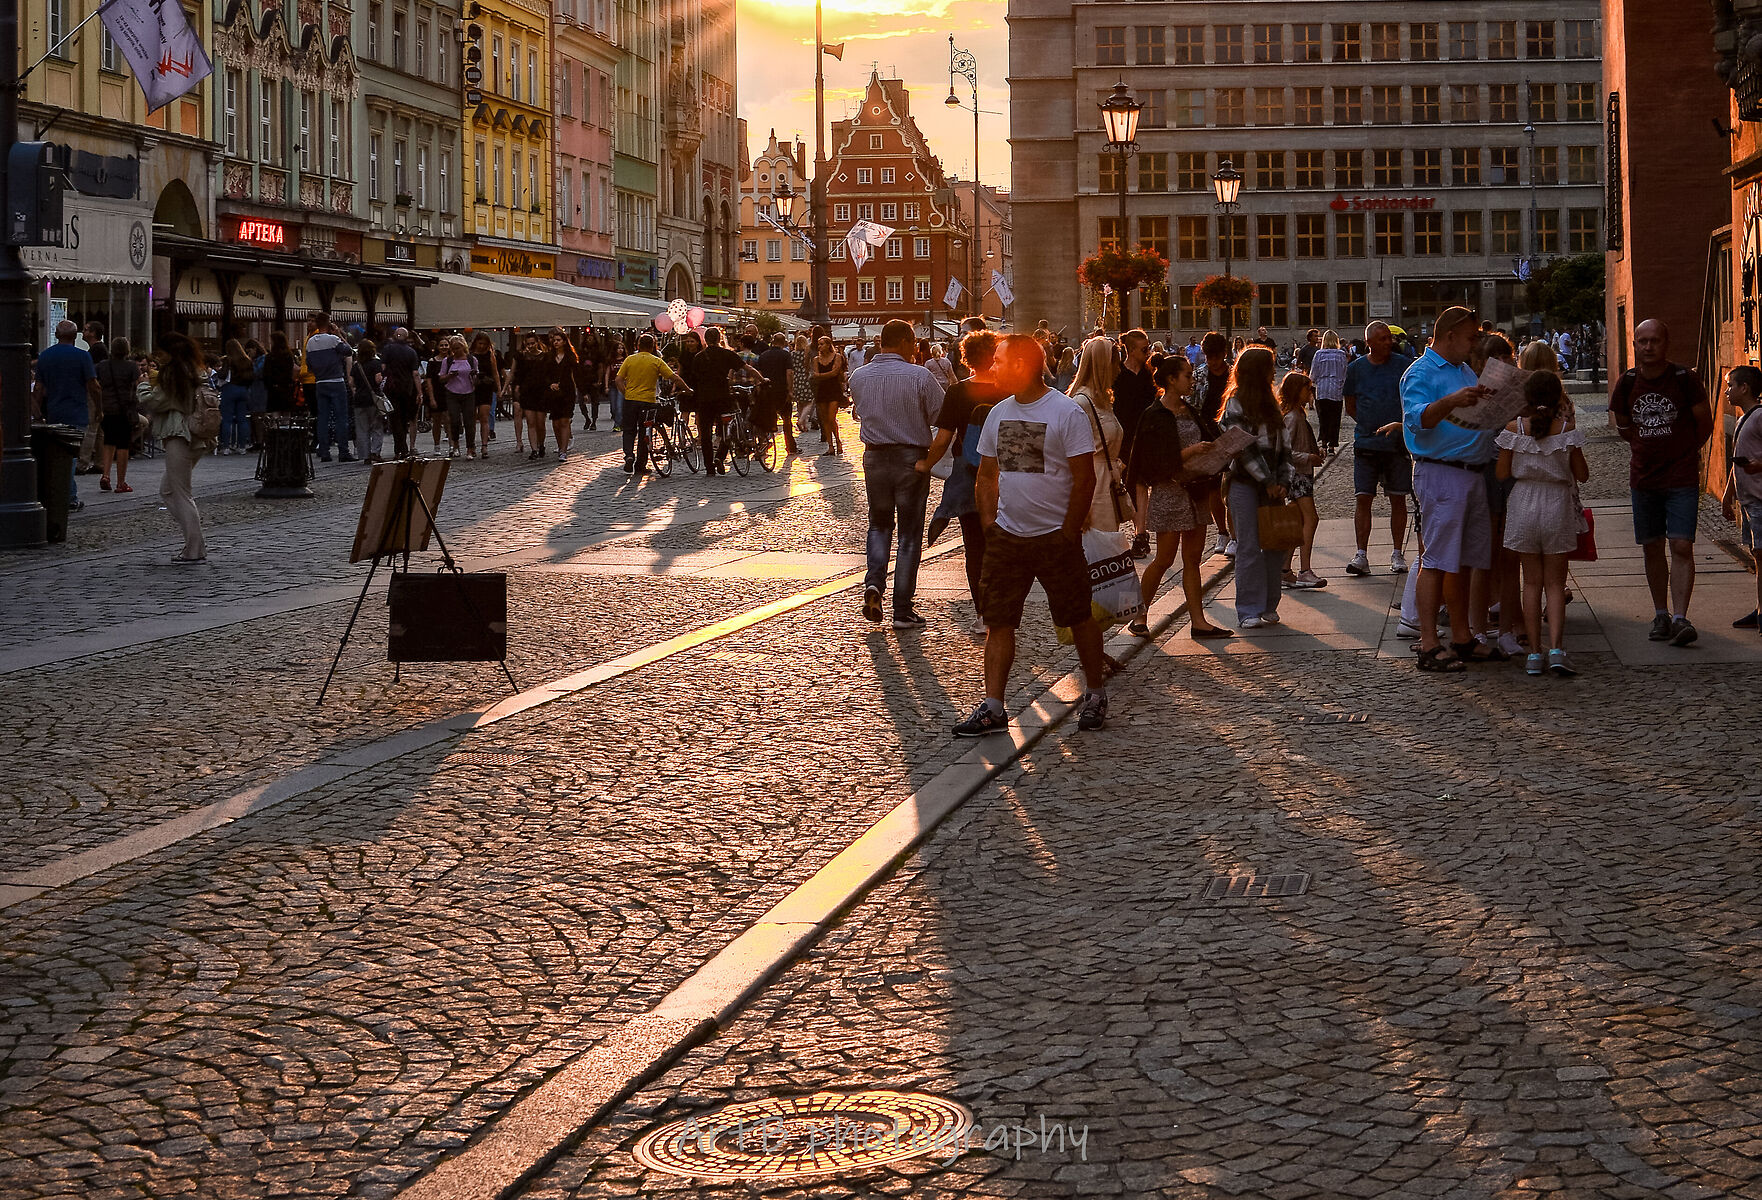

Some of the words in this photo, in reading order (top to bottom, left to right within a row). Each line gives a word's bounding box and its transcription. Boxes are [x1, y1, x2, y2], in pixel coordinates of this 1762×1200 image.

[1353, 195, 1436, 210] Santander
[65, 214, 80, 250] IS
[238, 221, 284, 244] APTEKA
[22, 249, 59, 263] VERNA
[1633, 393, 1674, 413] EAGLES
[1089, 556, 1133, 580] anova
